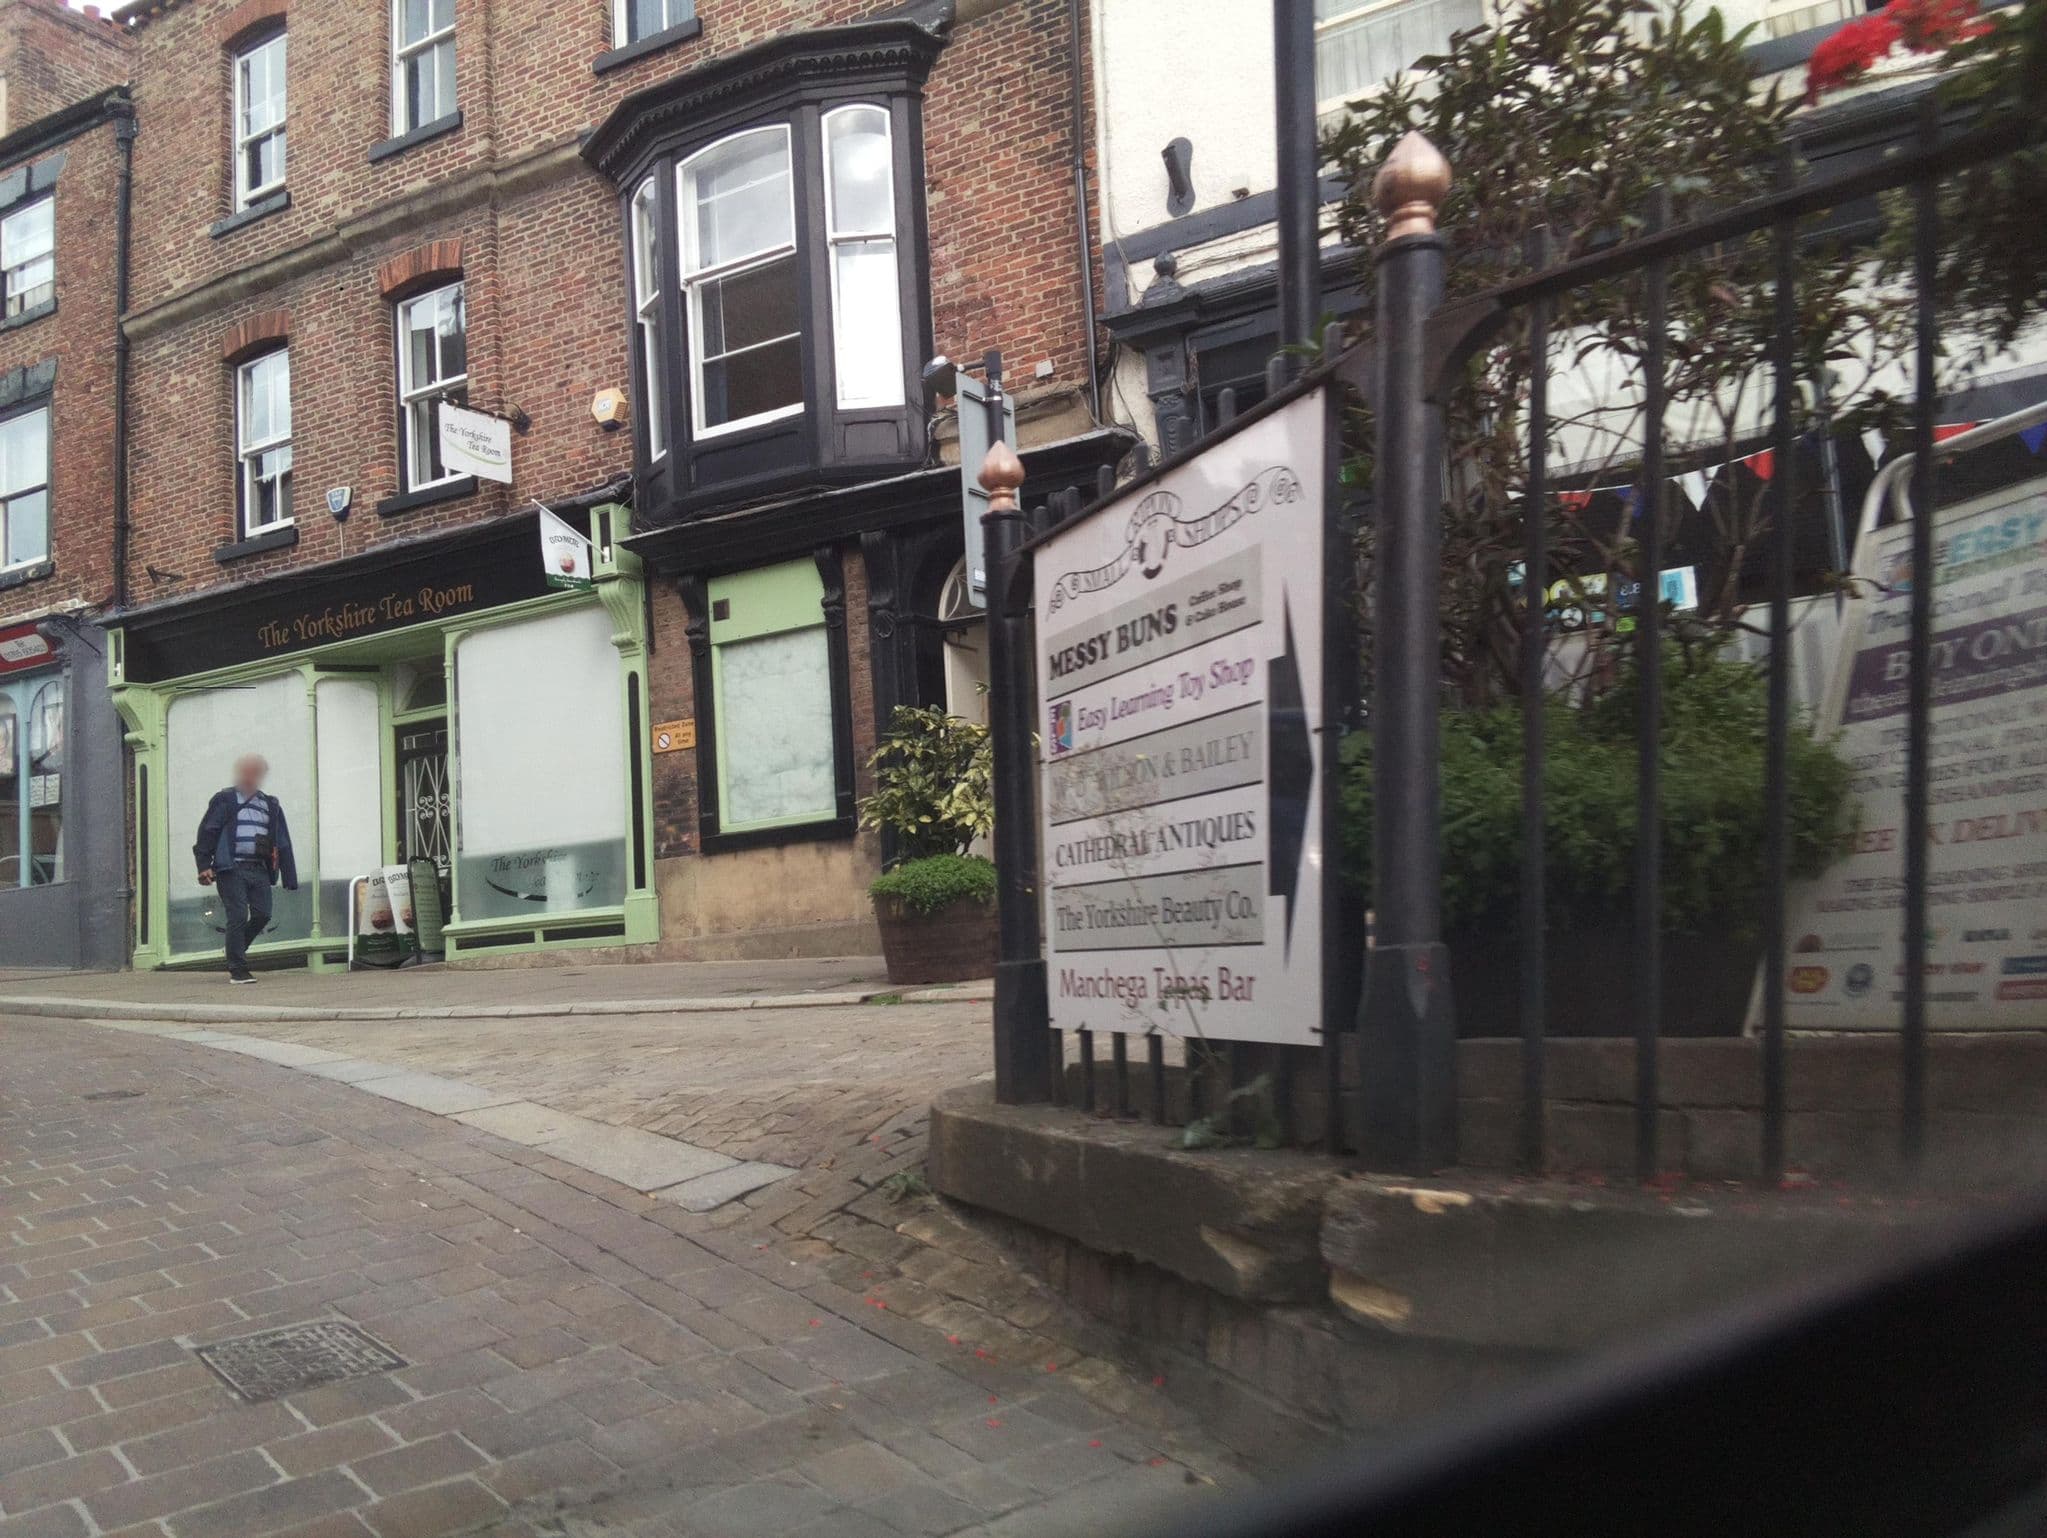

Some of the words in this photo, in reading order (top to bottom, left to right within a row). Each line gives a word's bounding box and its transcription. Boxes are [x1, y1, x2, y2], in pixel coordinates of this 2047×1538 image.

[444, 423, 458, 434] The
[459, 427, 492, 444] Yorkshire
[466, 440, 480, 451] Tea
[481, 445, 502, 456] Room
[257, 618, 290, 650] The
[292, 601, 377, 642] Yorkshire
[379, 592, 414, 620] Tea
[418, 581, 475, 614] Room
[1048, 629, 1113, 681] MESSY
[1115, 603, 1179, 654] BUNS
[1077, 705, 1107, 732] Easy
[1110, 681, 1175, 723] Learning
[1177, 670, 1206, 702] Toy
[1209, 655, 1256, 690] Shop
[1160, 756, 1177, 779] &
[1180, 730, 1255, 774] BAILEY
[1054, 828, 1150, 869] CATHEDRAL
[1157, 809, 1257, 853] ANTIQUES
[491, 855, 512, 873] The
[1057, 905, 1083, 931] The
[1085, 897, 1159, 928] Yorkshire
[1161, 894, 1222, 930] Beauty
[1224, 890, 1258, 921] Co.
[1059, 966, 1149, 1009] Manchega
[1152, 966, 1211, 1010] Tapas
[1216, 965, 1257, 1002] Bar
